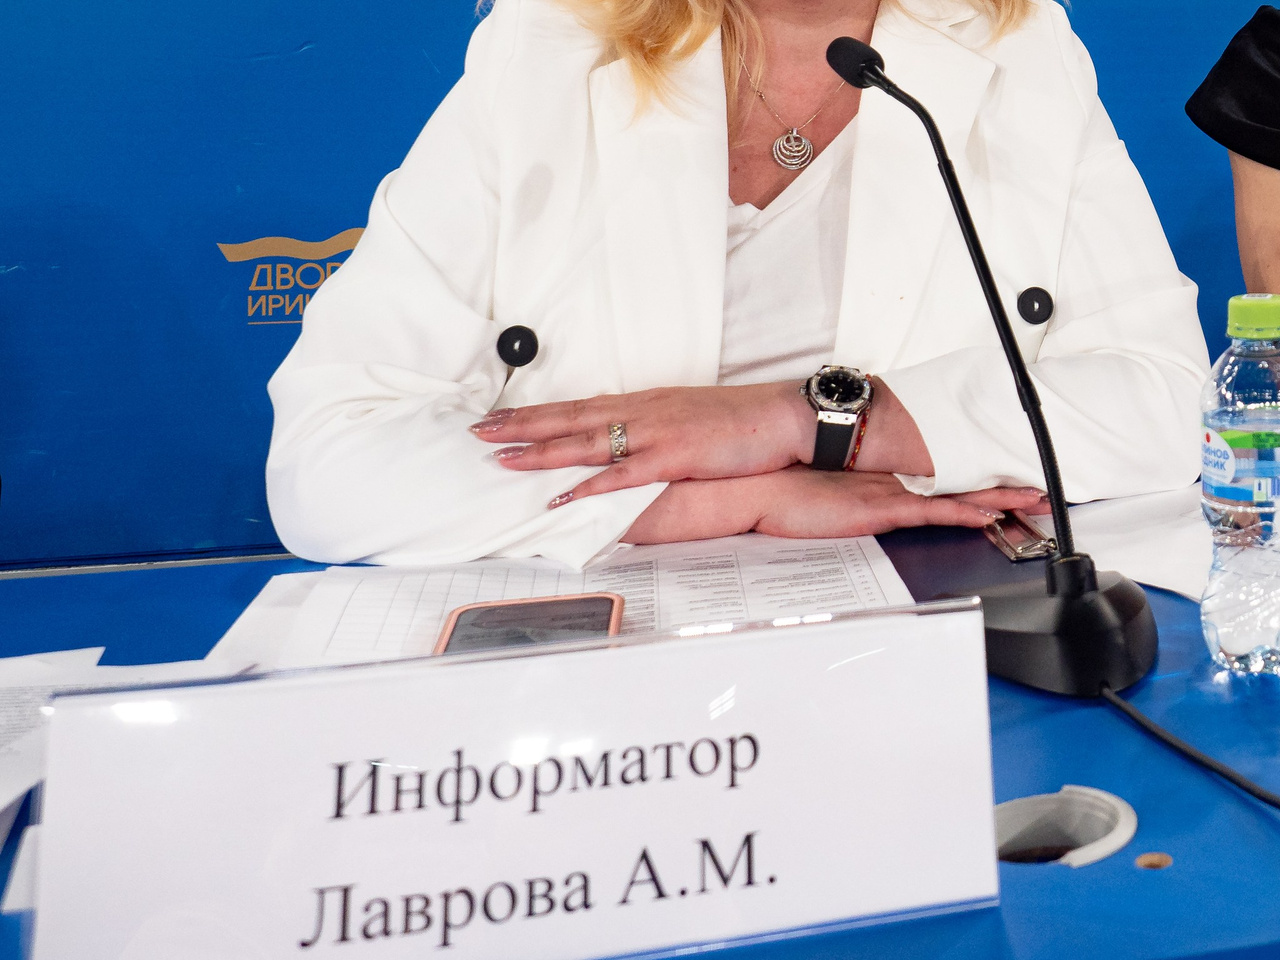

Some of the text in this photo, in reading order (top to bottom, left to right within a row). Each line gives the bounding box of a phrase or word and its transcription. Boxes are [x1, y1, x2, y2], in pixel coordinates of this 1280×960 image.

[328, 731, 760, 824] Информатор
[298, 831, 778, 948] Лаврова А.М.
